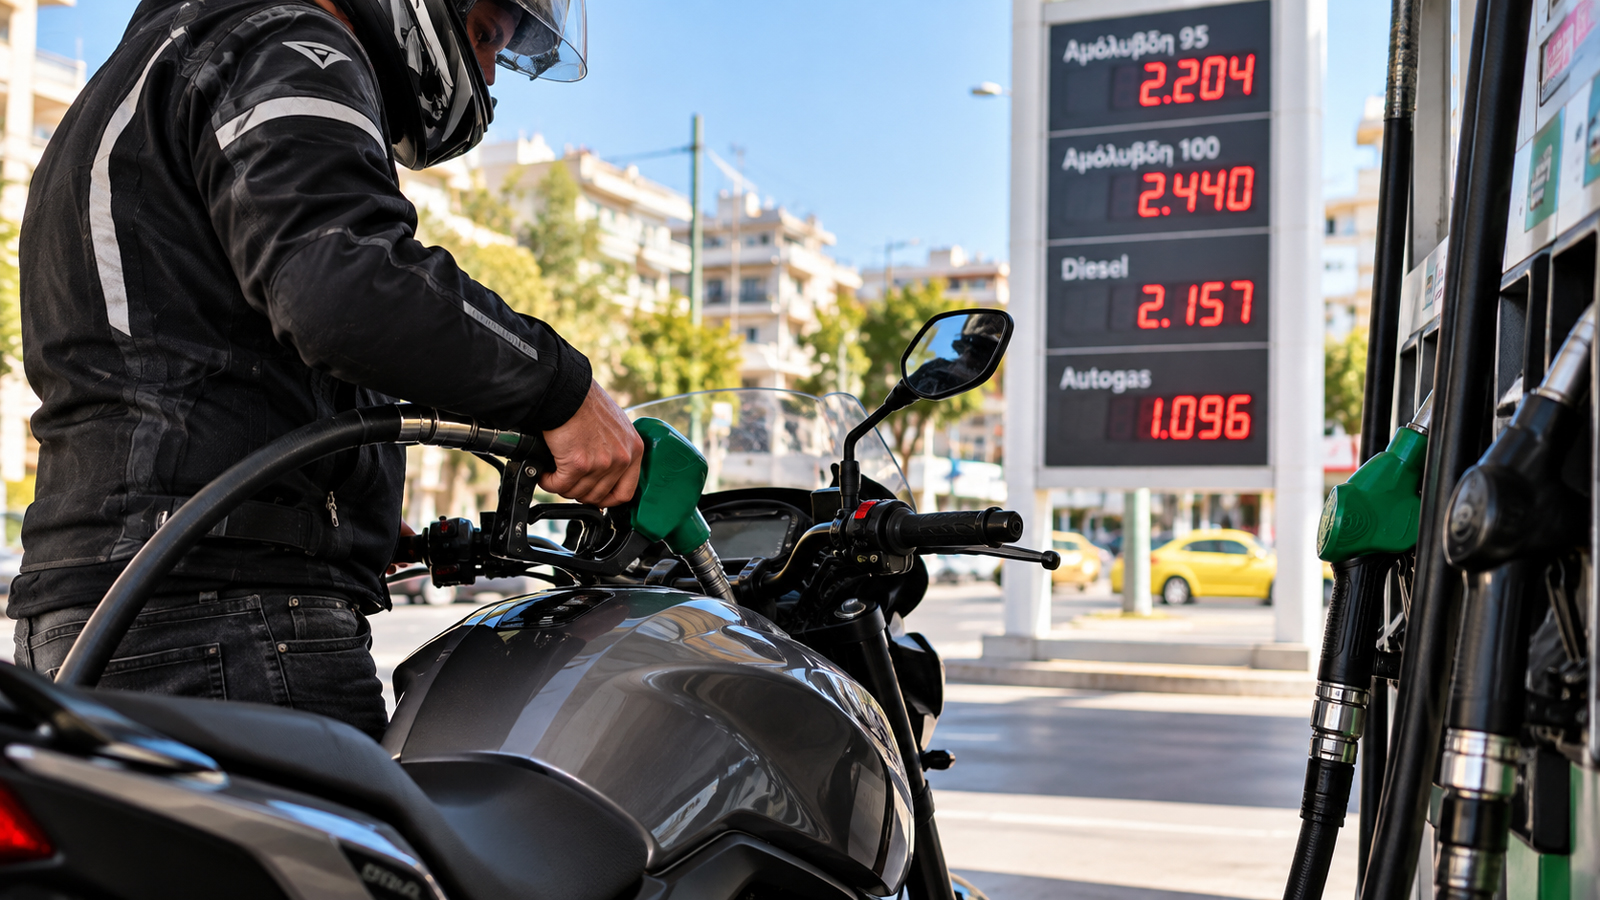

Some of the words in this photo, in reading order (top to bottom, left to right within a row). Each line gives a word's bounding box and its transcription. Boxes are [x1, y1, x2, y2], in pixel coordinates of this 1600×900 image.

[1063, 30, 1175, 66] Αμόλυβδη
[1179, 25, 1209, 50] 95
[1139, 53, 1256, 107] 2.204
[1062, 140, 1174, 174] Αμόλυβδη
[1179, 136, 1221, 161] 100
[1138, 166, 1255, 217] 2.440
[1061, 254, 1129, 281] Diesel
[1137, 280, 1254, 329] 2.157
[1060, 366, 1152, 394] Autogas
[1150, 394, 1251, 440] 1.096
